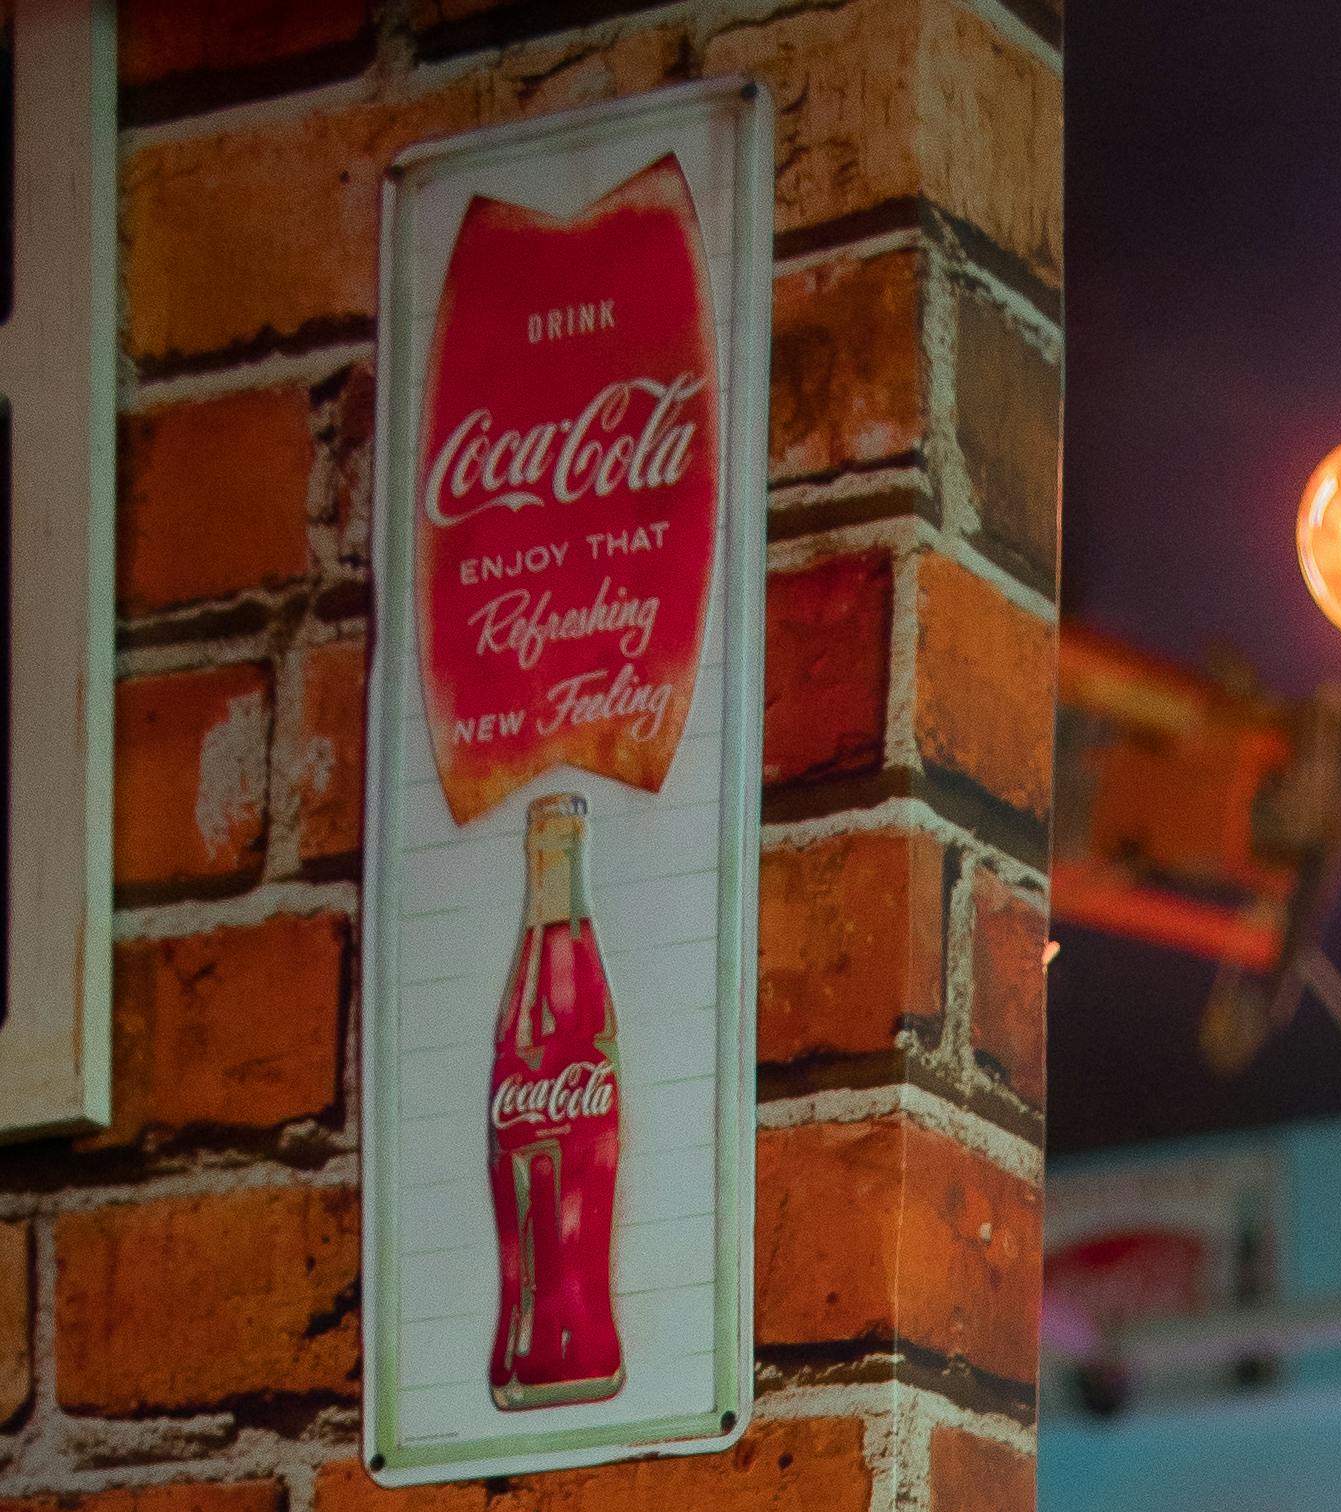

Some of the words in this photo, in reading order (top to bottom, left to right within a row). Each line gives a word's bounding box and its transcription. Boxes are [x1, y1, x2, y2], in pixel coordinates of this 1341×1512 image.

[528, 300, 616, 344] DRINK
[459, 541, 569, 585] ENJOY
[585, 521, 670, 558] THAT
[467, 577, 660, 670] Refreshing
[454, 709, 525, 746] NEW
[536, 663, 672, 742] Feeling
